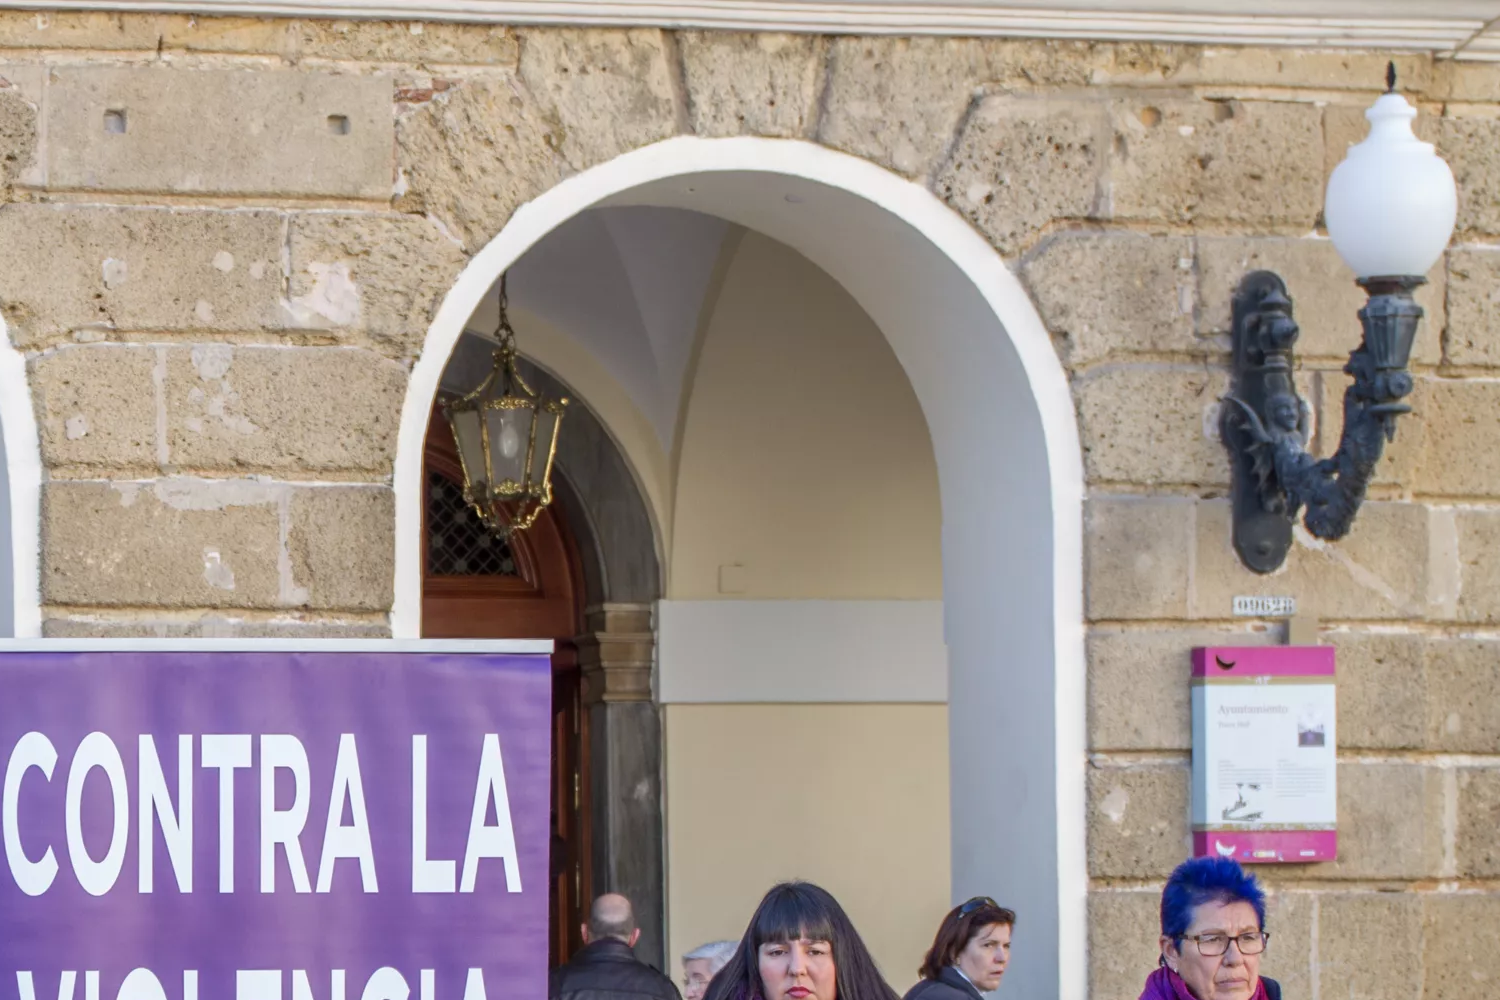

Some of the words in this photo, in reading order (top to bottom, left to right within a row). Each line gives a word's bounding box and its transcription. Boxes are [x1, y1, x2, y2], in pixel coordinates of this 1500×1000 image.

[1218, 704, 1289, 717] Ayuntamiento
[2, 731, 379, 897] CONTRA
[412, 733, 523, 893] LA
